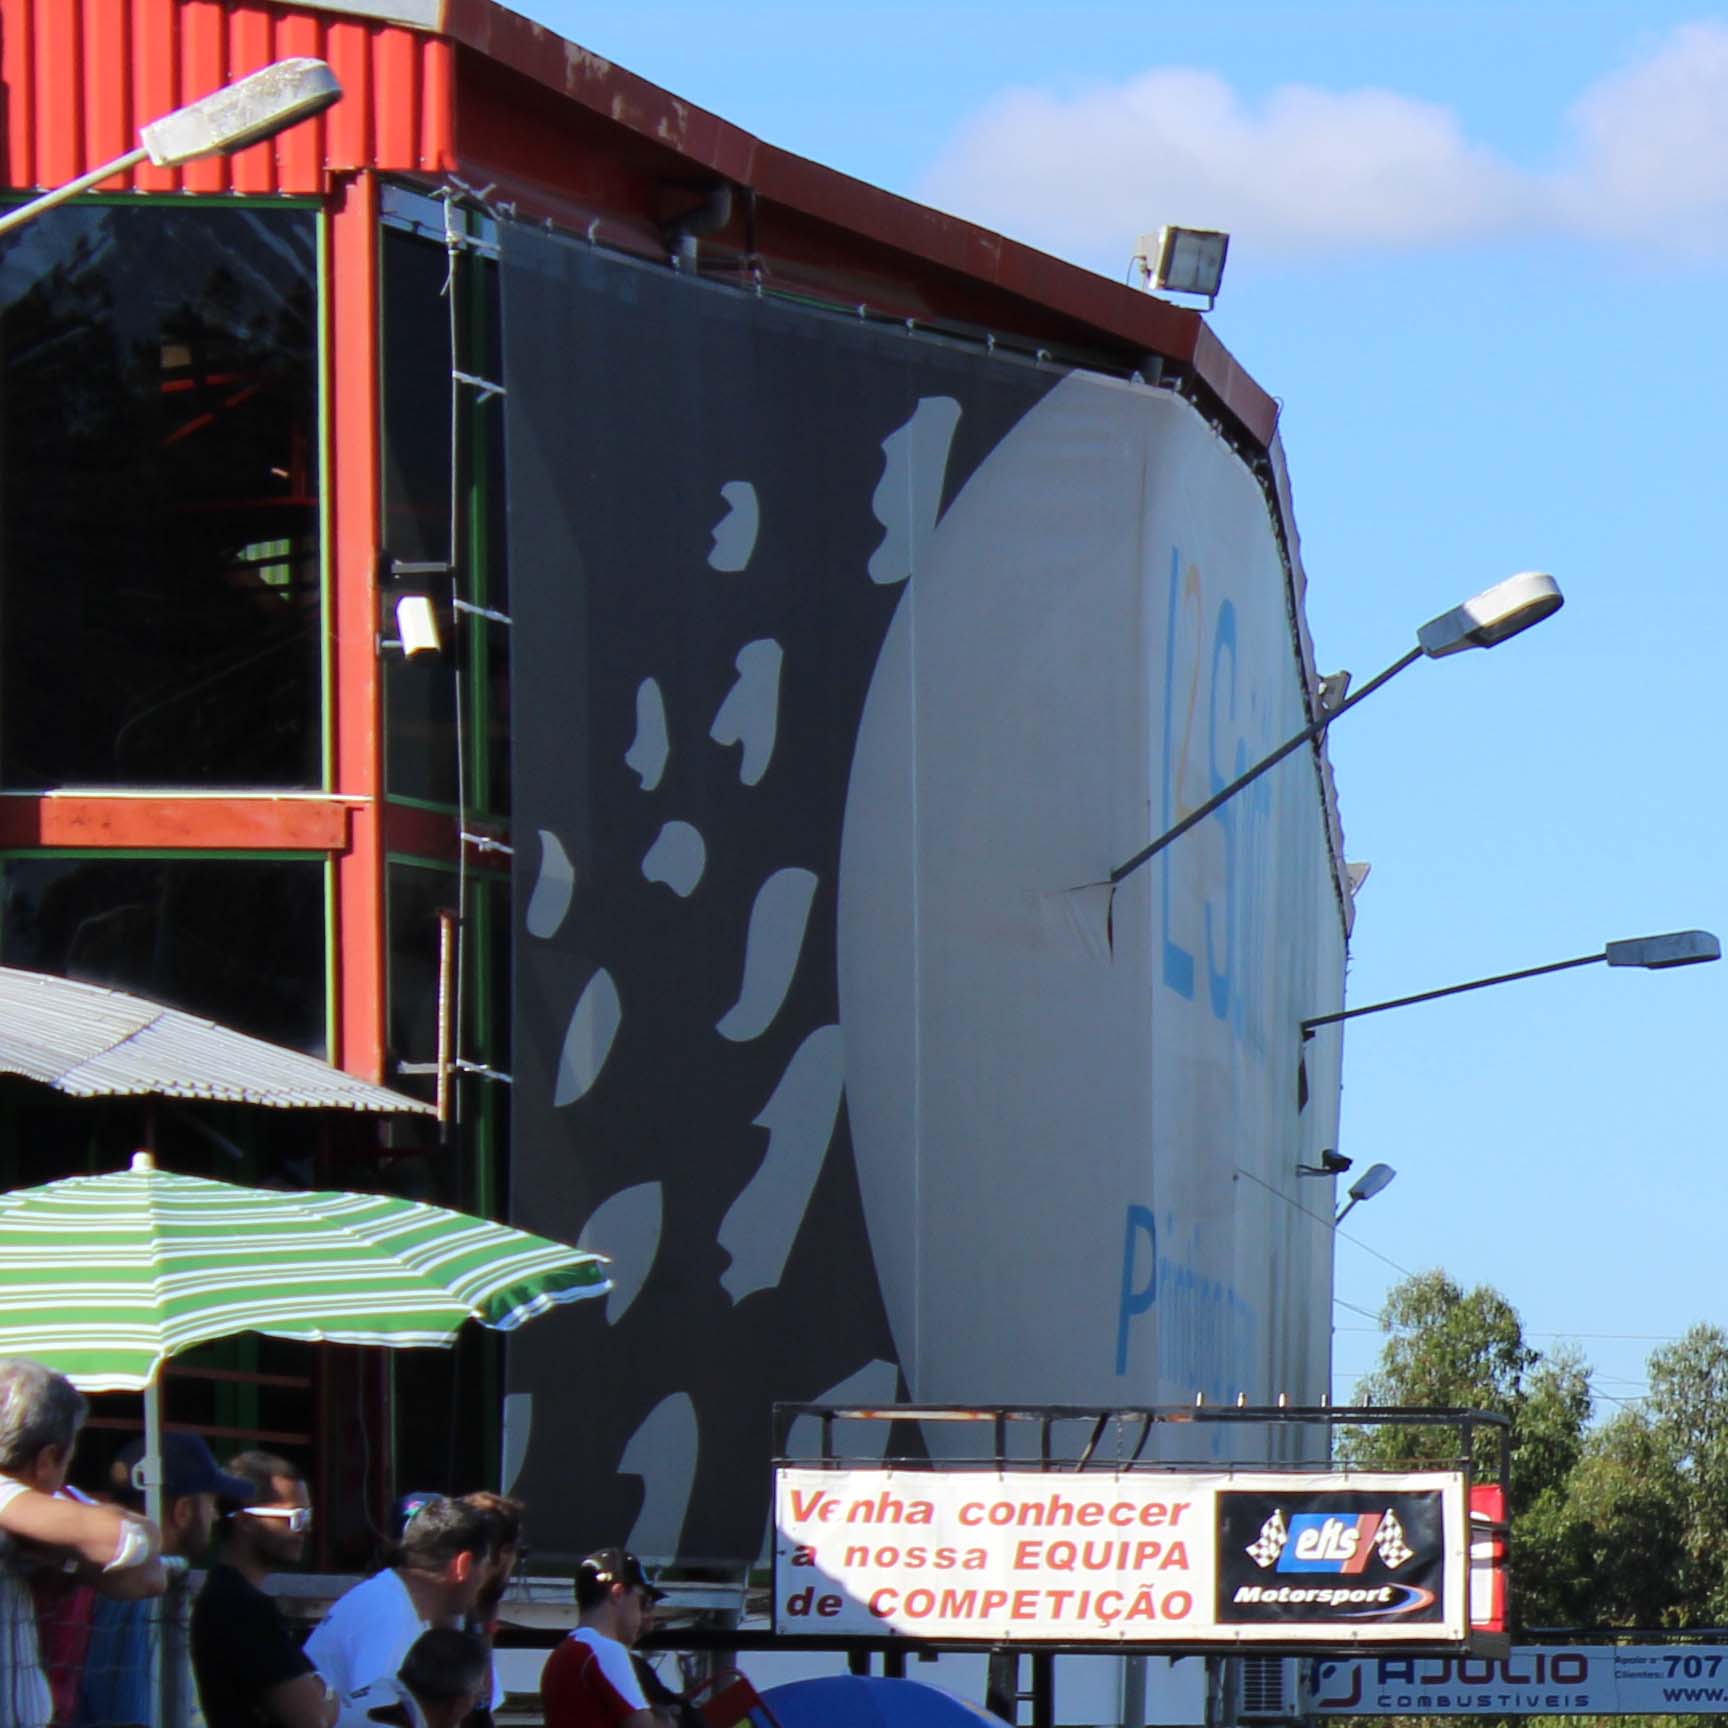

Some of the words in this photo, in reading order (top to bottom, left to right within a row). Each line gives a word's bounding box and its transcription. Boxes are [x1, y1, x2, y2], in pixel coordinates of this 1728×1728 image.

[790, 1488, 934, 1525] Venha
[958, 1493, 1191, 1527] conhecer
[791, 1544, 817, 1568] a
[844, 1545, 988, 1570] nossa
[1013, 1540, 1190, 1572] EQUIPA
[786, 1586, 843, 1618] de
[868, 1583, 1193, 1628] COMPETIÇÃO
[1233, 1586, 1391, 1607] Motorsport
[1662, 1655, 1724, 1679] 707
